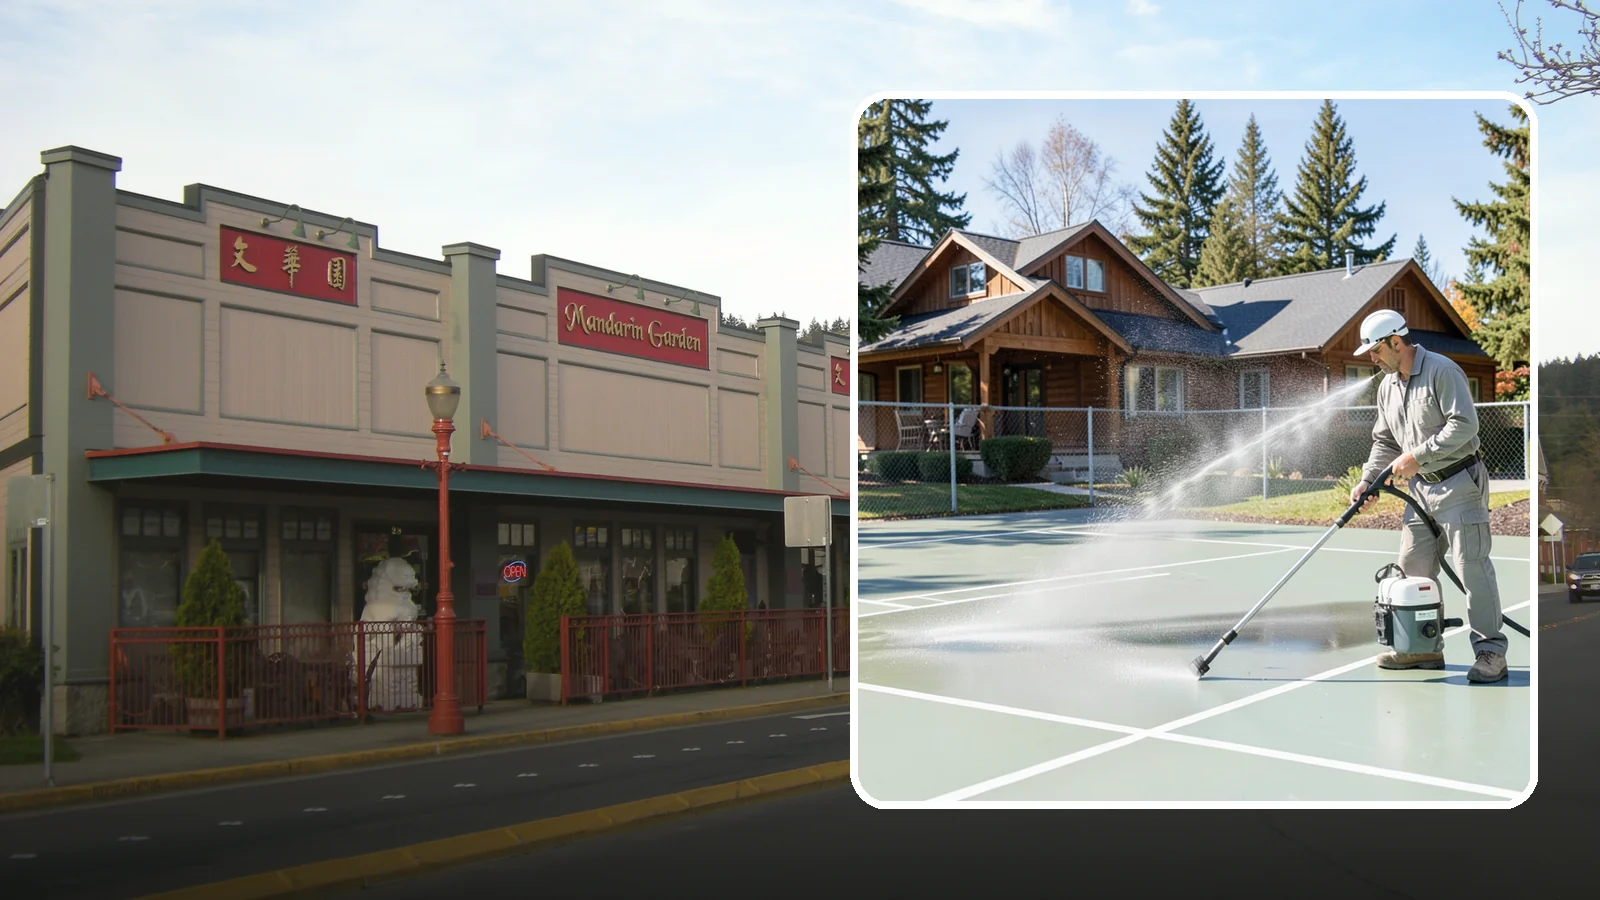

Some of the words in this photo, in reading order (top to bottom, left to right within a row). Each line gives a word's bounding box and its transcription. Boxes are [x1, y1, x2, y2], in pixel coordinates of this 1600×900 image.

[231, 236, 346, 291] 文華園
[564, 302, 644, 341] Mandarin
[647, 320, 701, 352] Garden
[503, 565, 527, 578] OPEN
